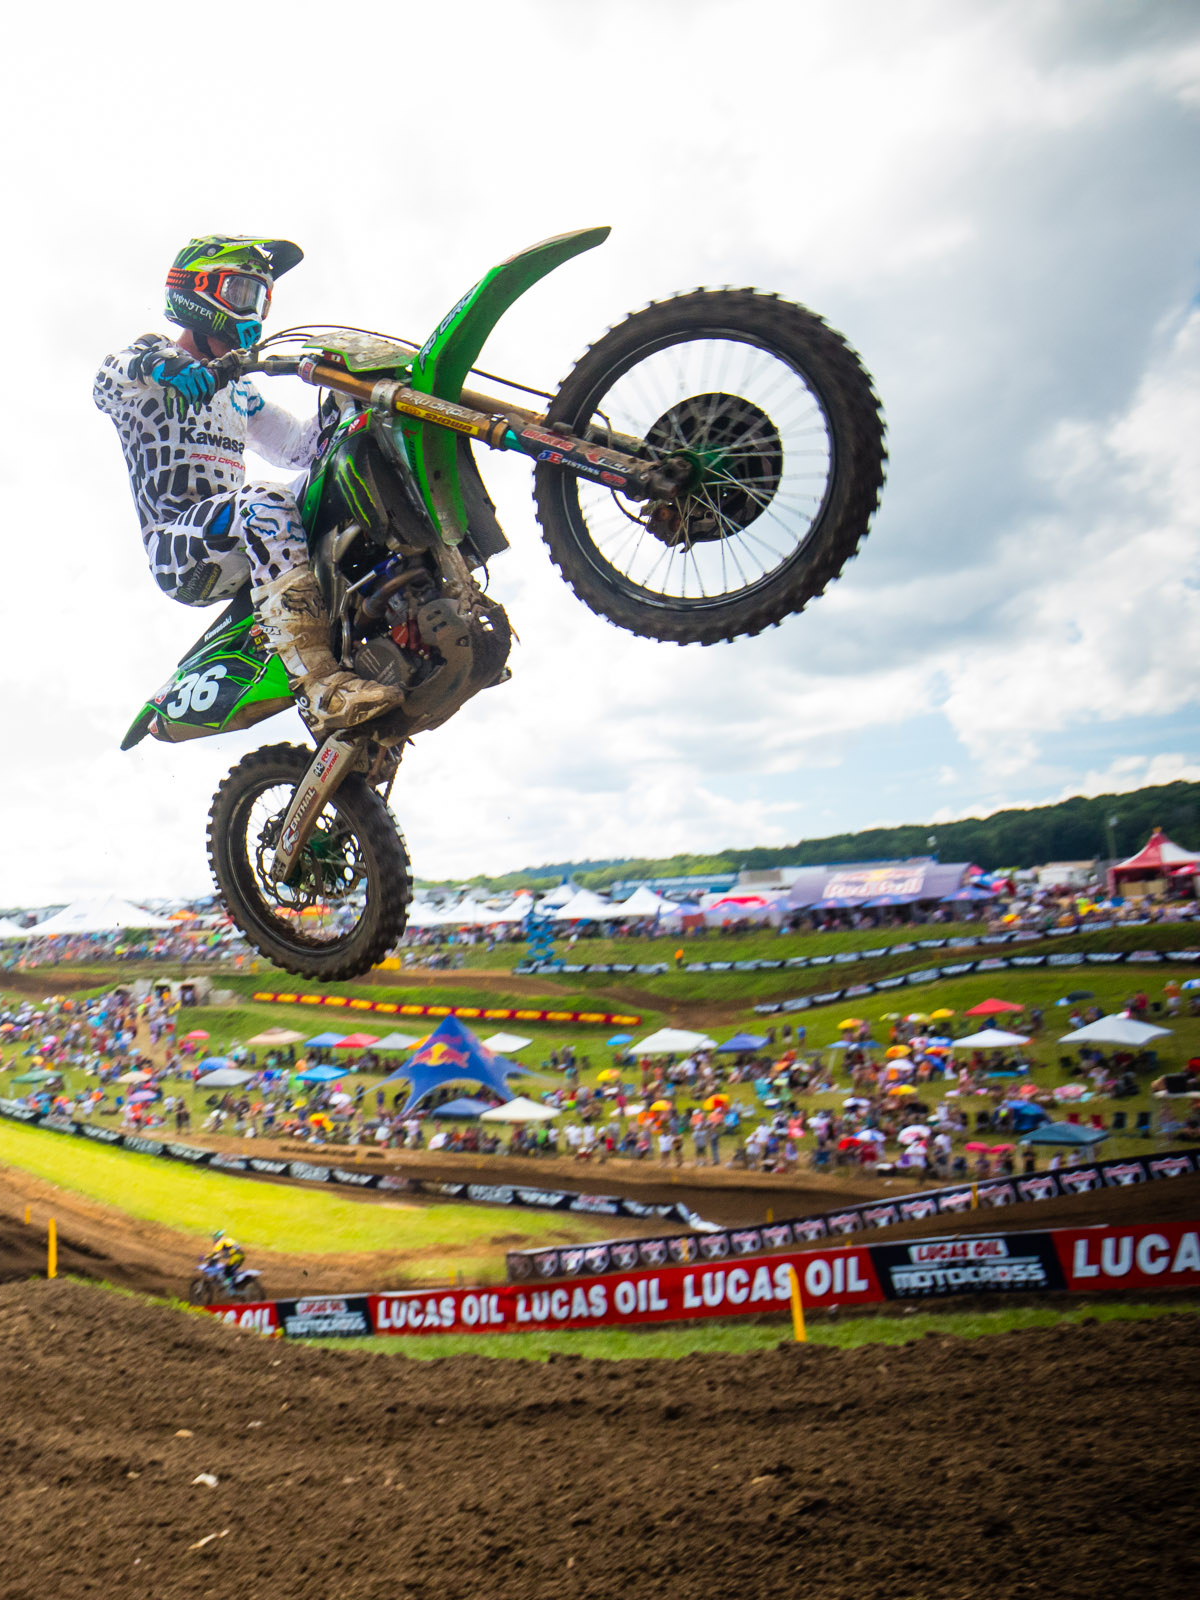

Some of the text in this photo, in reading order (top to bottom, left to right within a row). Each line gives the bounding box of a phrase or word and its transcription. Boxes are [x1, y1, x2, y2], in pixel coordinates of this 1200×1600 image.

[173, 292, 212, 320] MONSTER
[423, 412, 473, 432] SHOWA
[520, 429, 576, 452] BRAKING
[189, 452, 217, 462] PRO
[537, 450, 563, 464] JE
[561, 458, 601, 476] PISTONS
[204, 615, 233, 643] Kawasaki
[166, 664, 228, 719] 36
[320, 752, 340, 783] BRAKING
[321, 747, 332, 763] RK
[917, 1241, 1002, 1261] LUCAS OIL
[683, 1256, 869, 1309] LUCAS OIL
[891, 1263, 1047, 1290] MOTOCROSS
[378, 1294, 505, 1328] LUCAS OIL
[516, 1278, 668, 1322] LUCAS OIL
